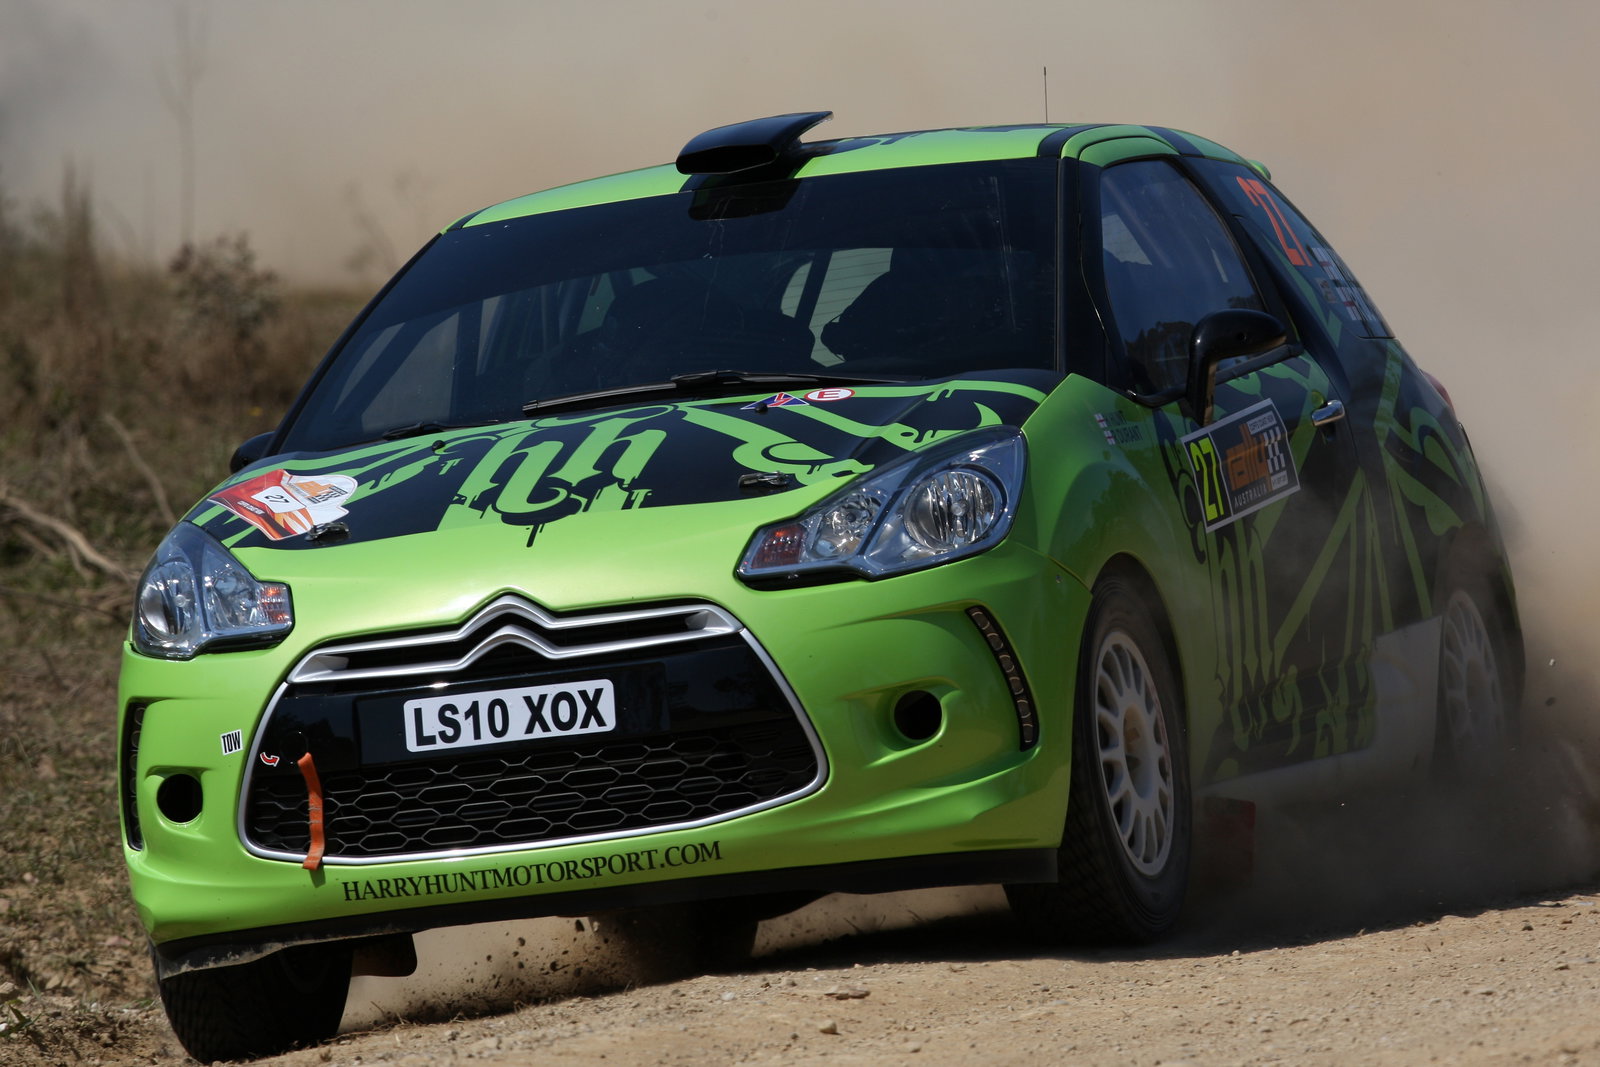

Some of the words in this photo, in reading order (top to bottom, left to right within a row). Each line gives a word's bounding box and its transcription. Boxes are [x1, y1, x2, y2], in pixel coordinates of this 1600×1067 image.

[1236, 175, 1313, 267] 27
[816, 389, 841, 399] E
[264, 494, 290, 504] 27
[1189, 437, 1225, 521] 27
[1234, 483, 1268, 508] AUSTRALIA
[413, 698, 510, 747] LS10
[522, 687, 607, 735] XOX
[221, 730, 241, 754] TOW
[342, 841, 722, 901] HARRYHUNTMOTORSPORT.COM
